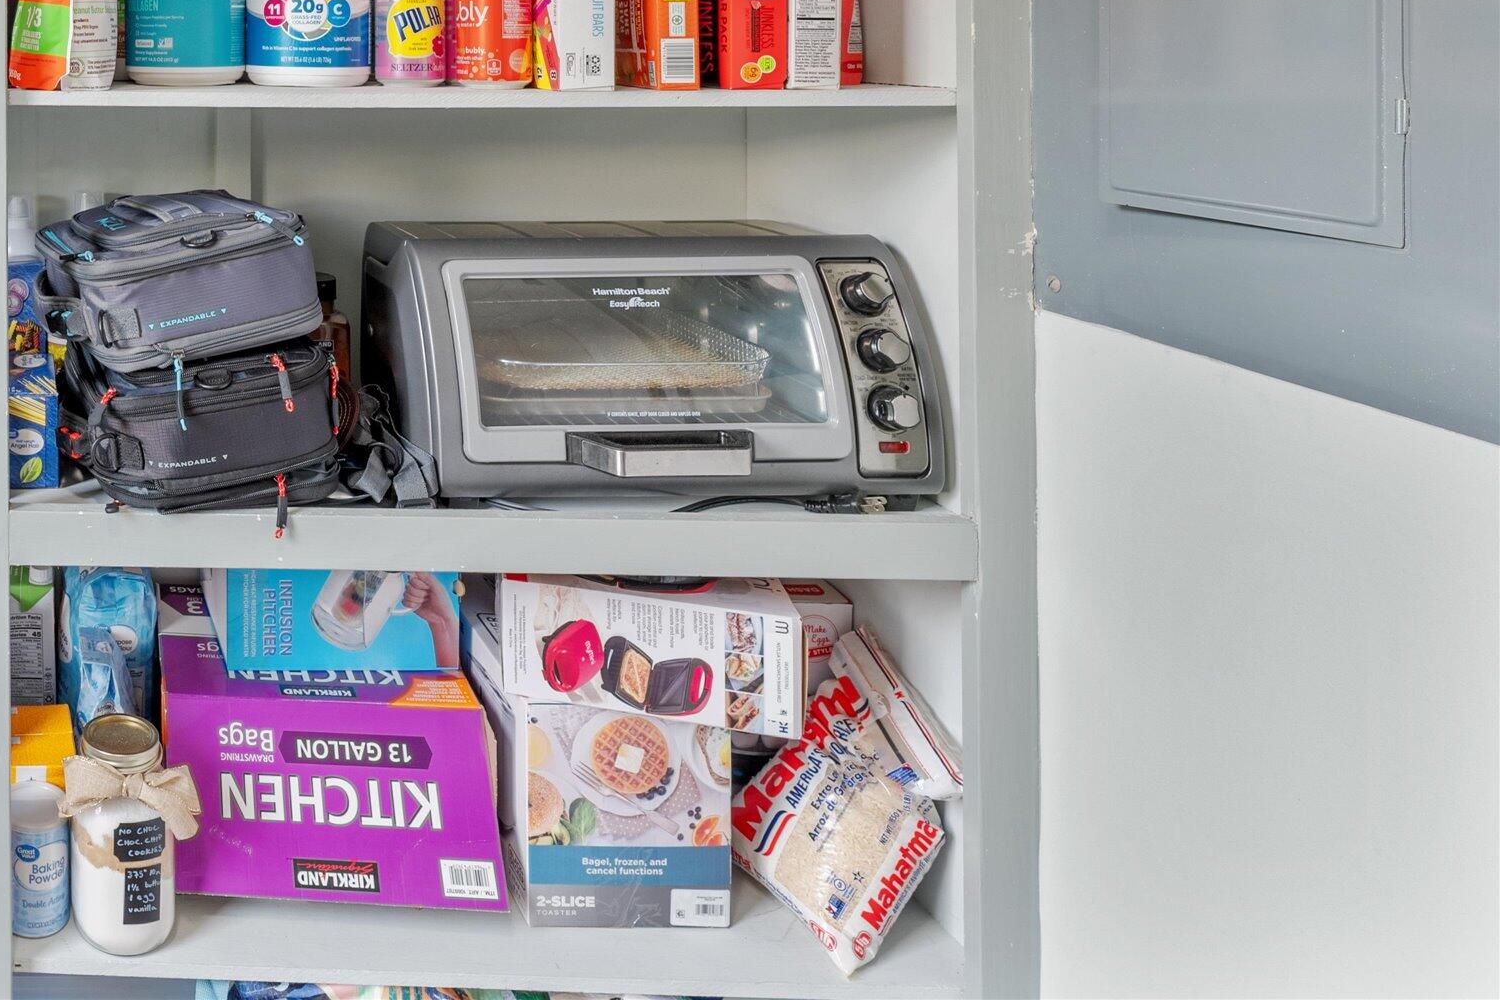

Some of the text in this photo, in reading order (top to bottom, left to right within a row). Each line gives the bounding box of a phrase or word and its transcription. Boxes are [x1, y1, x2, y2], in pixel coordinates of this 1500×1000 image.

[392, 5, 442, 41] POLAR
[594, 10, 603, 38] BARS
[764, 5, 774, 49] JUNKLESS
[390, 62, 433, 73] SELTZER
[592, 287, 669, 297] Hamilton Beach
[160, 311, 216, 328] EXPANDABLE
[158, 457, 216, 468] EXPANDABLE
[263, 588, 276, 657] PITCHER
[279, 579, 293, 657] INFUSION
[812, 635, 829, 645] Eggs
[283, 687, 352, 698] KIRKLAND
[219, 723, 274, 752] Bags
[220, 752, 274, 762] DRAWSTRING
[297, 739, 411, 762] 13 GALLON
[219, 773, 442, 829] KITCHEN
[17, 847, 36, 855] Great
[32, 858, 65, 873] Baking
[582, 857, 667, 870] Bagel, frozen, and
[586, 865, 663, 875] cancel functions
[29, 869, 64, 884] Powder
[297, 872, 375, 889] KIRKLAND
[861, 820, 938, 930] Mahatma
[128, 904, 157, 912] vanilla
[536, 895, 596, 908] 2-SLICE
